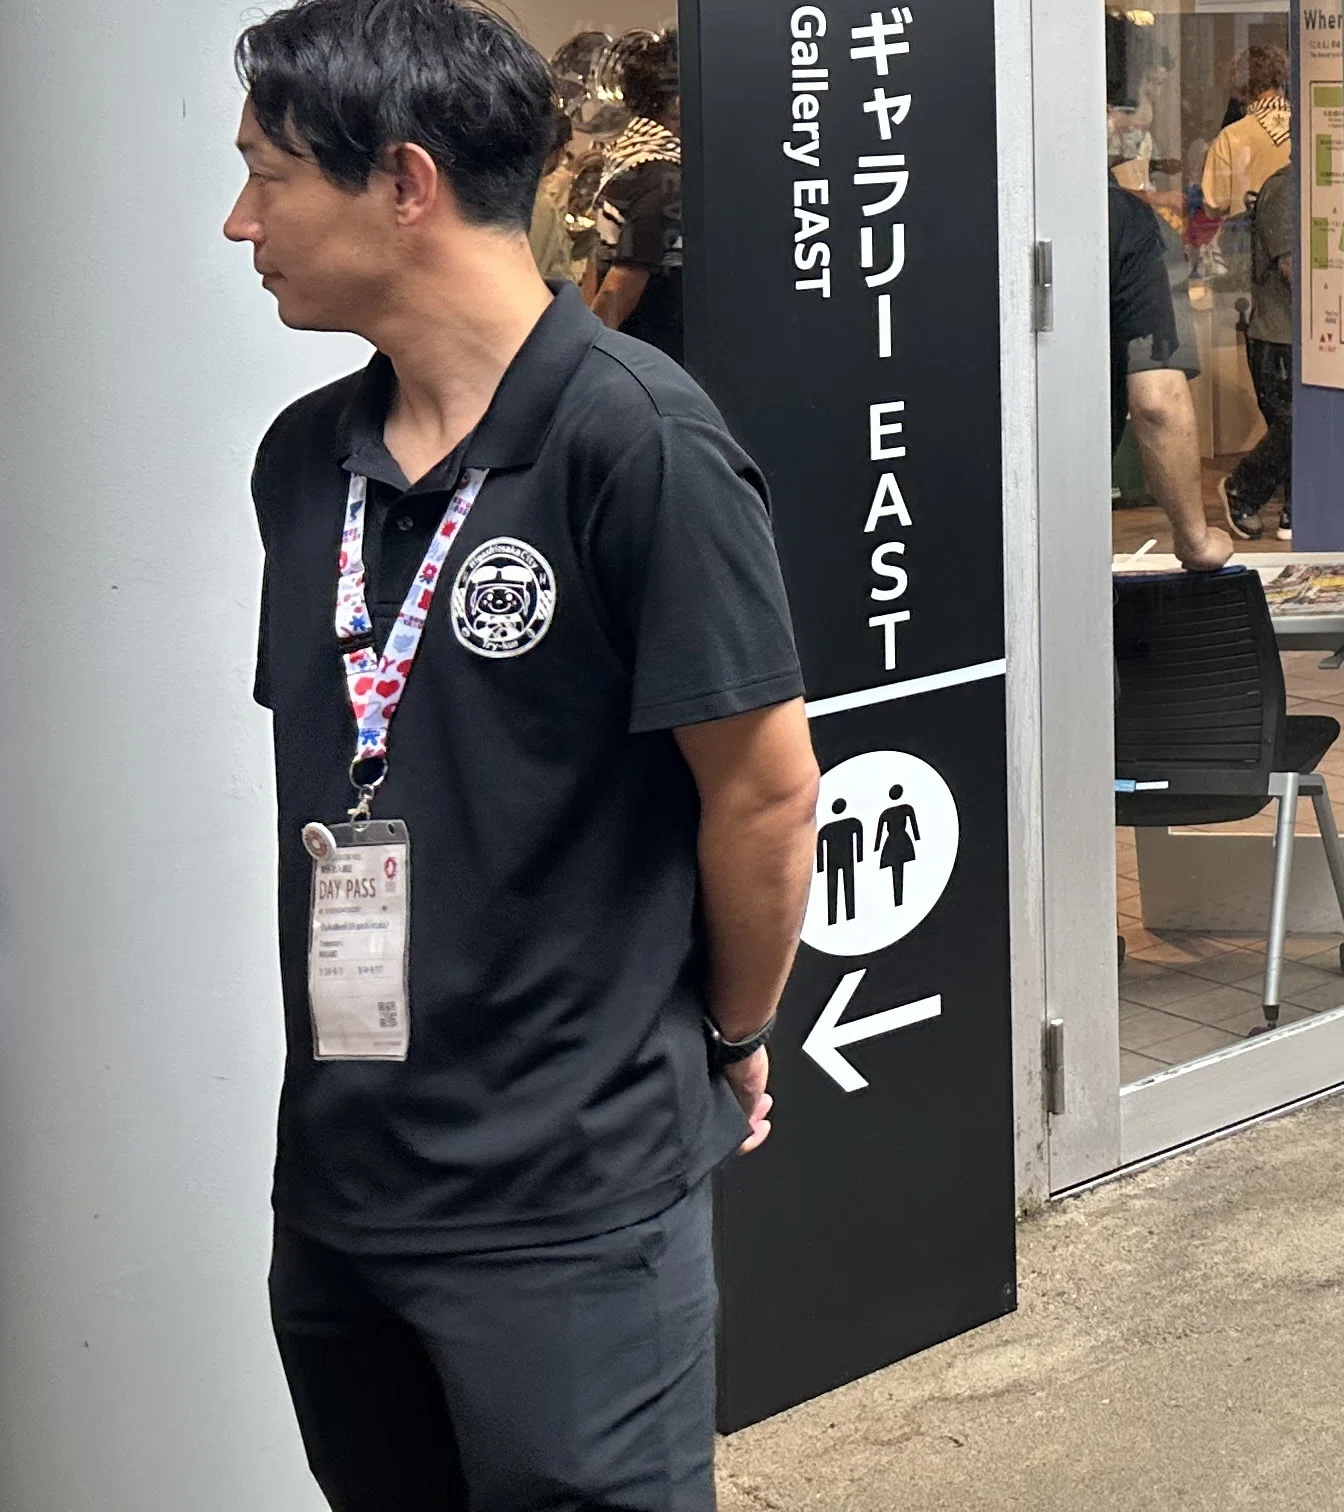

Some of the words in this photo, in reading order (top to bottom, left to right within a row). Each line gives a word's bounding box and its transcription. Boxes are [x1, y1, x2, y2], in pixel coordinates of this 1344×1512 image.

[783, 4, 829, 167] Gallery
[1303, 9, 1343, 31] Wher
[792, 178, 832, 299] EAST
[848, 5, 914, 360] ギャラリー
[863, 399, 913, 671] EAST
[318, 879, 342, 900] DAY
[346, 877, 376, 899] PASS
